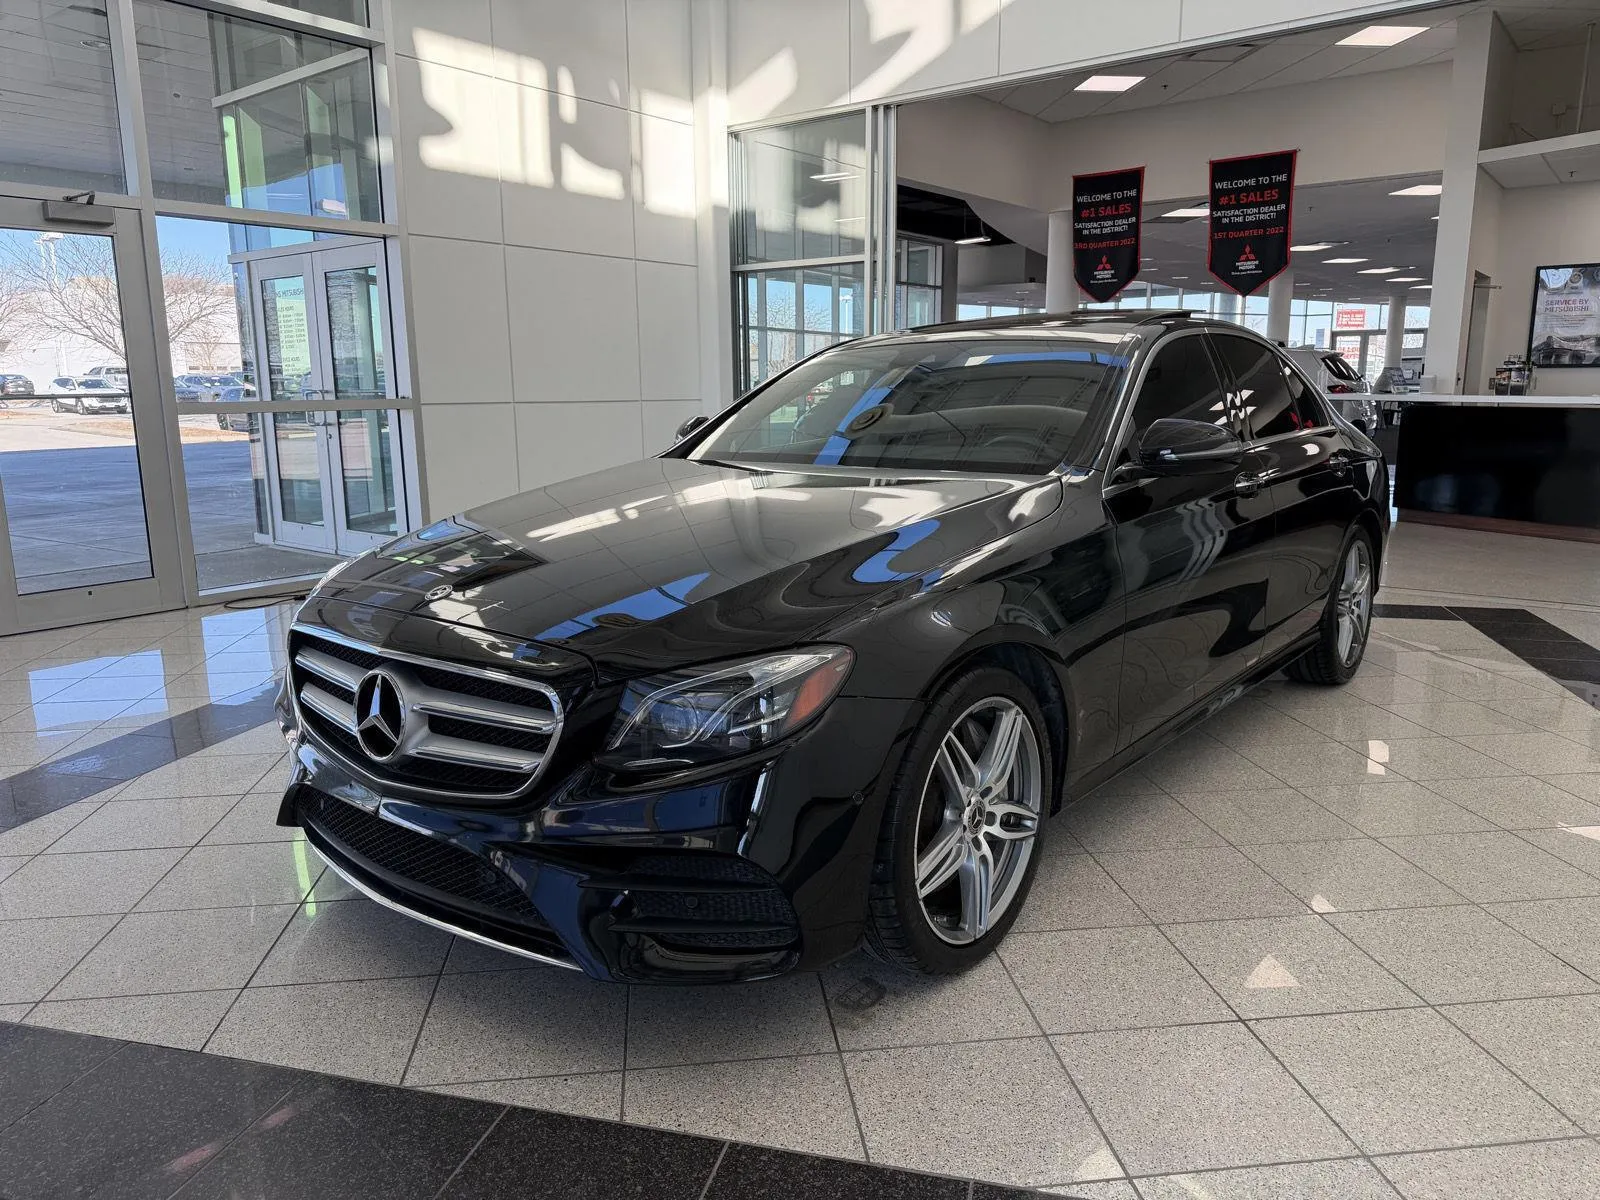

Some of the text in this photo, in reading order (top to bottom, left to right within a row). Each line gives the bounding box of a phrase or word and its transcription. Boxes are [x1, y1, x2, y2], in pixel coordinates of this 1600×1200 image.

[1215, 174, 1288, 189] WELCOME TO THE
[1077, 189, 1137, 202] WELCOME TO THE
[1219, 189, 1279, 205] #1 SALES
[1081, 204, 1131, 217] #1 SALES
[1213, 204, 1286, 217] SATISFACTION DEALER
[1074, 217, 1136, 229] SATISFACTION DEALER
[1229, 229, 1264, 239] QUARTER
[1266, 226, 1284, 234] 2022
[1089, 241, 1119, 249] QUARTER
[1120, 238, 1136, 246] 2022
